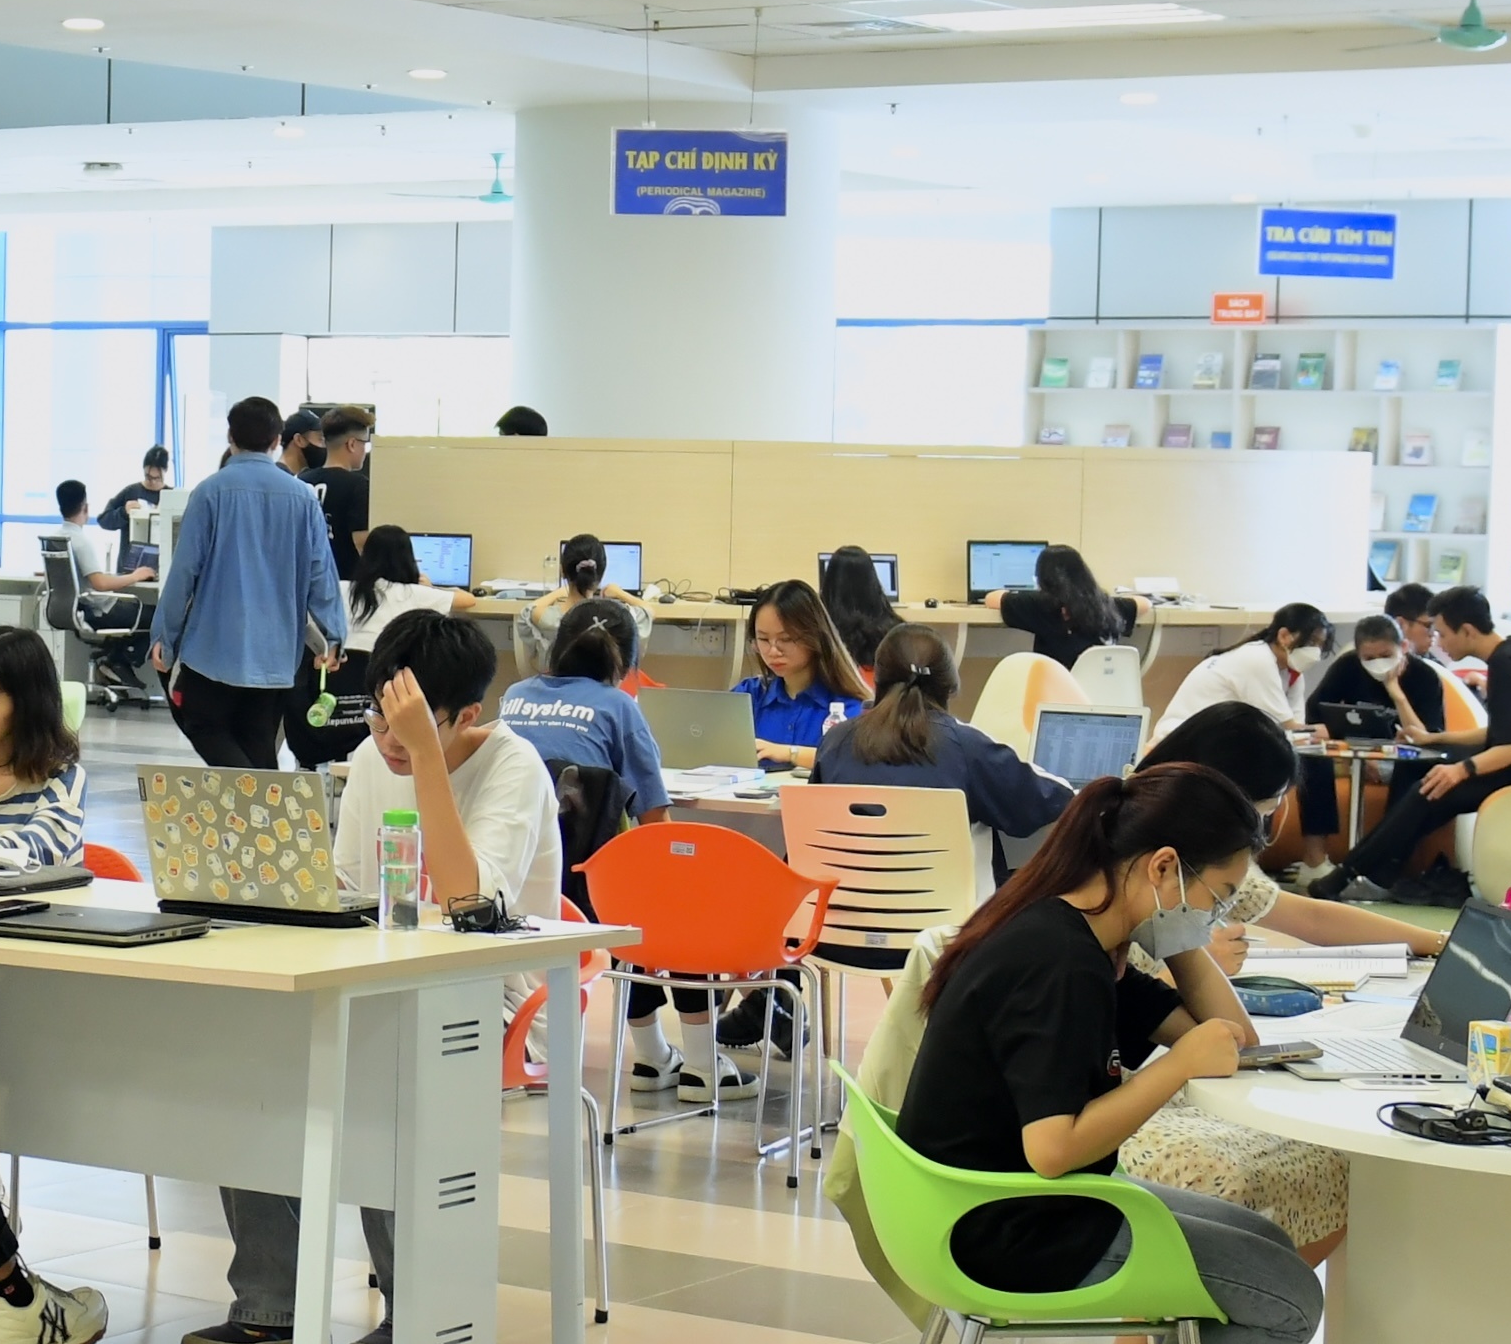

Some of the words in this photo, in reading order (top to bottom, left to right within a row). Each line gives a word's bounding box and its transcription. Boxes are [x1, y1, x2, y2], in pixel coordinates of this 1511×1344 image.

[625, 150, 660, 173] TẠP
[664, 147, 698, 170] CHÍ
[701, 152, 748, 174] ĐỊNH
[753, 148, 779, 171] KỲ
[636, 186, 704, 197] (PERIODICAL
[706, 187, 766, 199] MAGAZINE)
[1265, 226, 1296, 243] TRA
